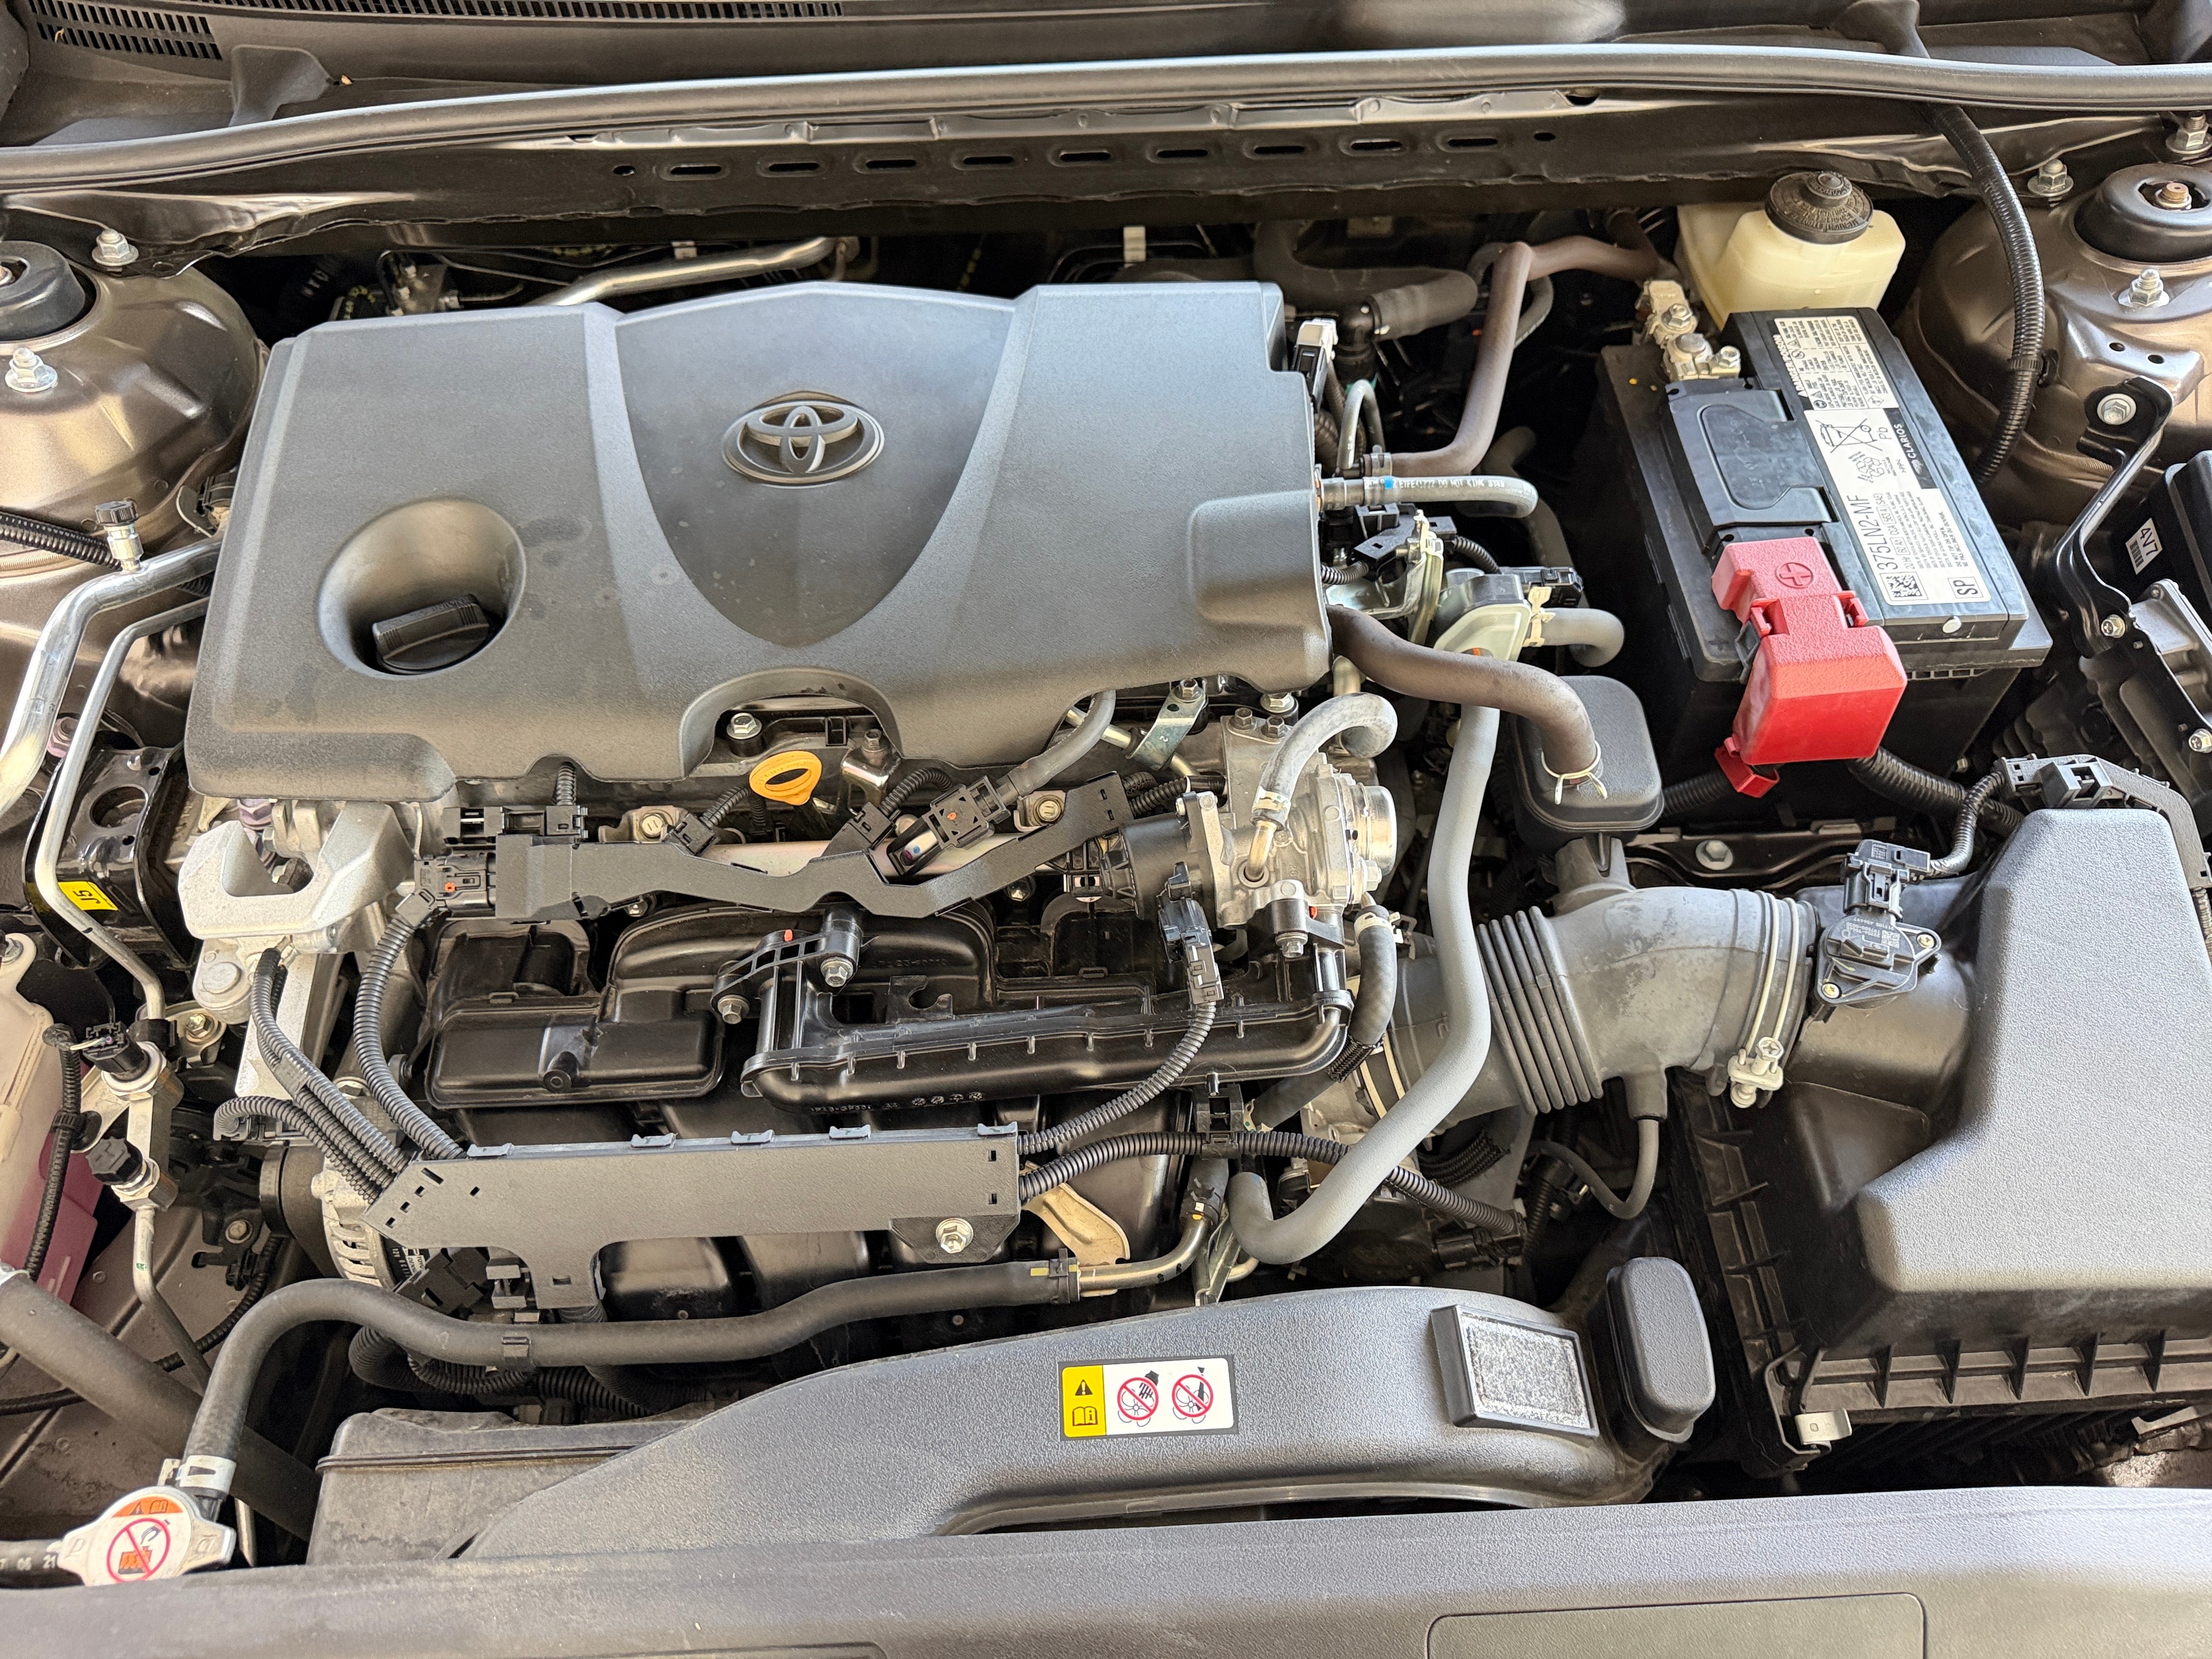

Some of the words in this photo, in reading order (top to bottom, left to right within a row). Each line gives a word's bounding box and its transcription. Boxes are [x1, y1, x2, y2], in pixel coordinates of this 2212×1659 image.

[1876, 427, 1888, 439] Pb
[1893, 424, 1917, 459] CLARIOS
[1846, 494, 1899, 569] 375LN2-MF
[2140, 527, 2158, 556] 4V7
[1953, 580, 1979, 595] SP
[72, 890, 101, 904] J5
